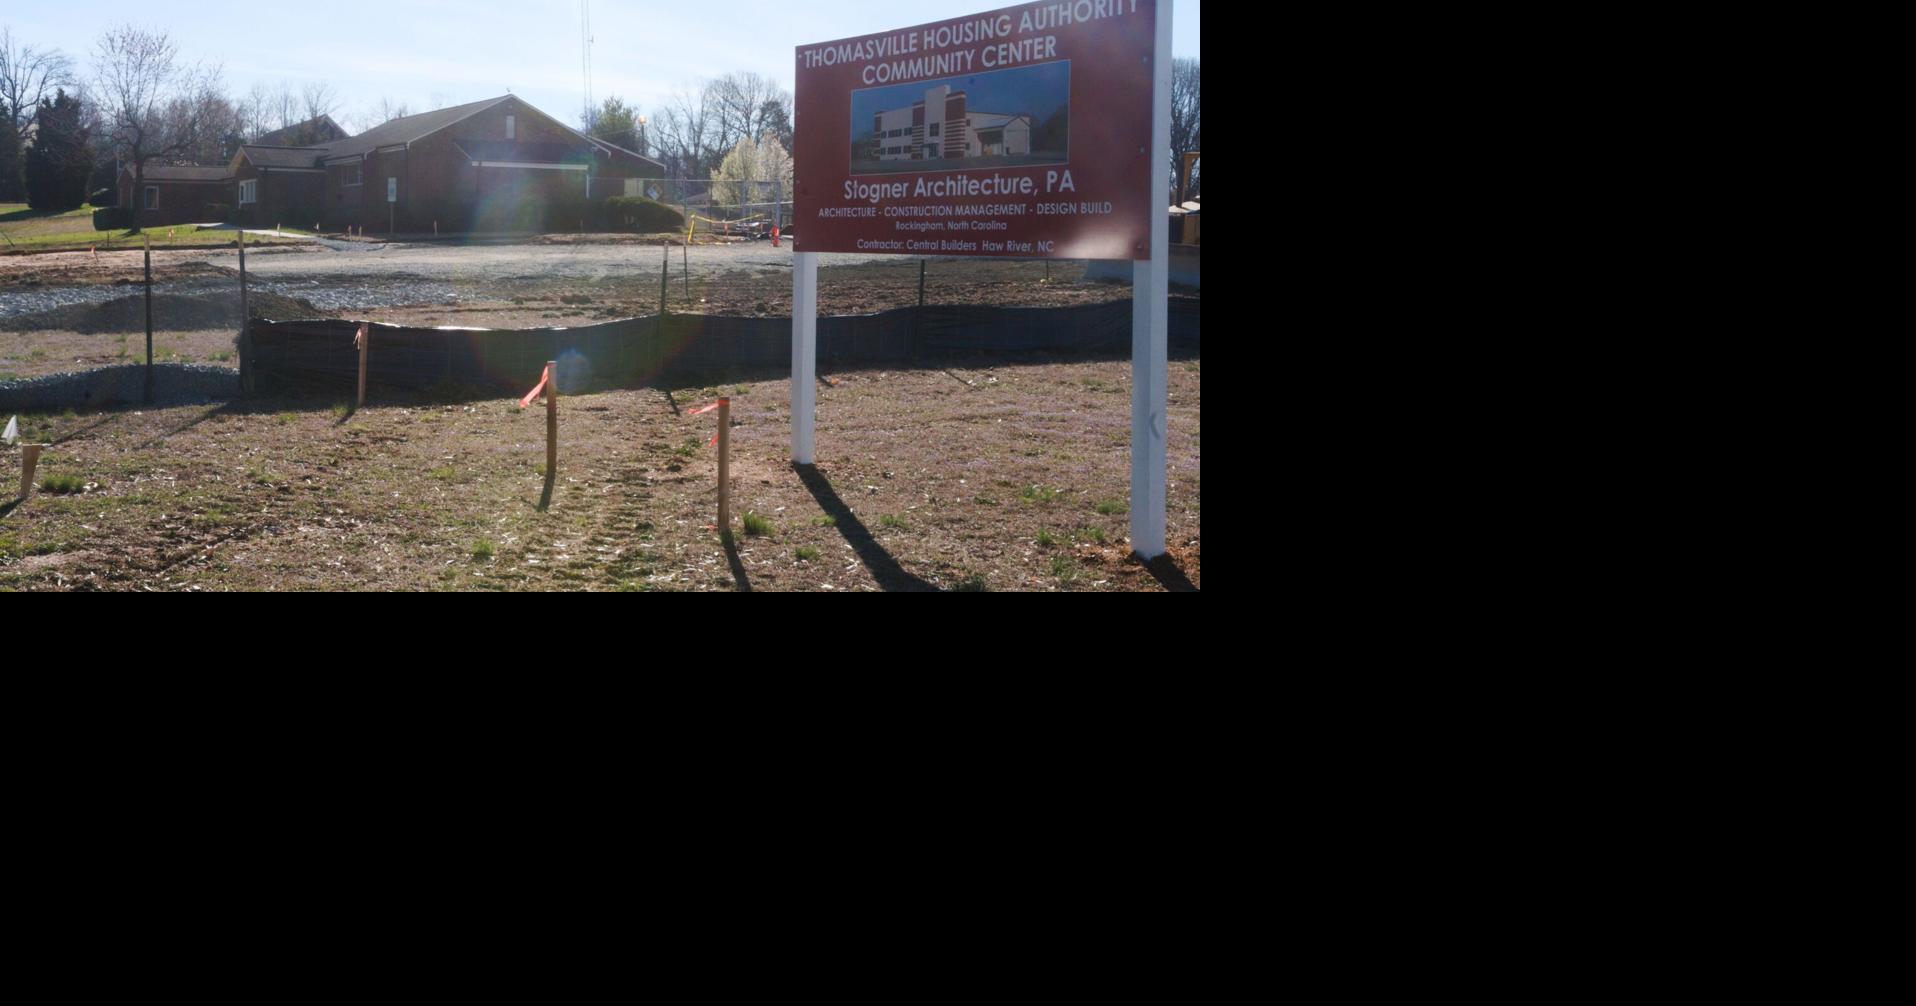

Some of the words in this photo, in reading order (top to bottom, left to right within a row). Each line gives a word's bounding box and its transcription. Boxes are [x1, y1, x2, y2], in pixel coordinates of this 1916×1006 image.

[804, 32, 918, 69] THOMASVILLE
[924, 14, 1012, 50] HOUSING
[1019, 0, 1137, 33] AUTHORITY
[862, 49, 976, 85] COMMUNITY
[981, 35, 1057, 68] CENTER
[844, 180, 909, 203] Stogner
[913, 173, 1038, 197] Architecture,
[1046, 169, 1075, 193] PA
[818, 207, 876, 218] ARCHITECTURE
[884, 205, 952, 217] CONSTRUCTION
[955, 203, 1027, 216] MANAGEMENT
[1036, 203, 1077, 215] DESIGN
[1080, 202, 1112, 214] BUILD
[895, 220, 945, 232] Rockingham,
[947, 221, 969, 231] North
[970, 220, 1007, 231] Carolina
[857, 238, 904, 249] Contractor:
[906, 239, 938, 250] Central
[941, 239, 977, 250] Builders
[982, 240, 1004, 251] Haw
[1007, 240, 1034, 252] River,
[1037, 241, 1054, 252] NC
